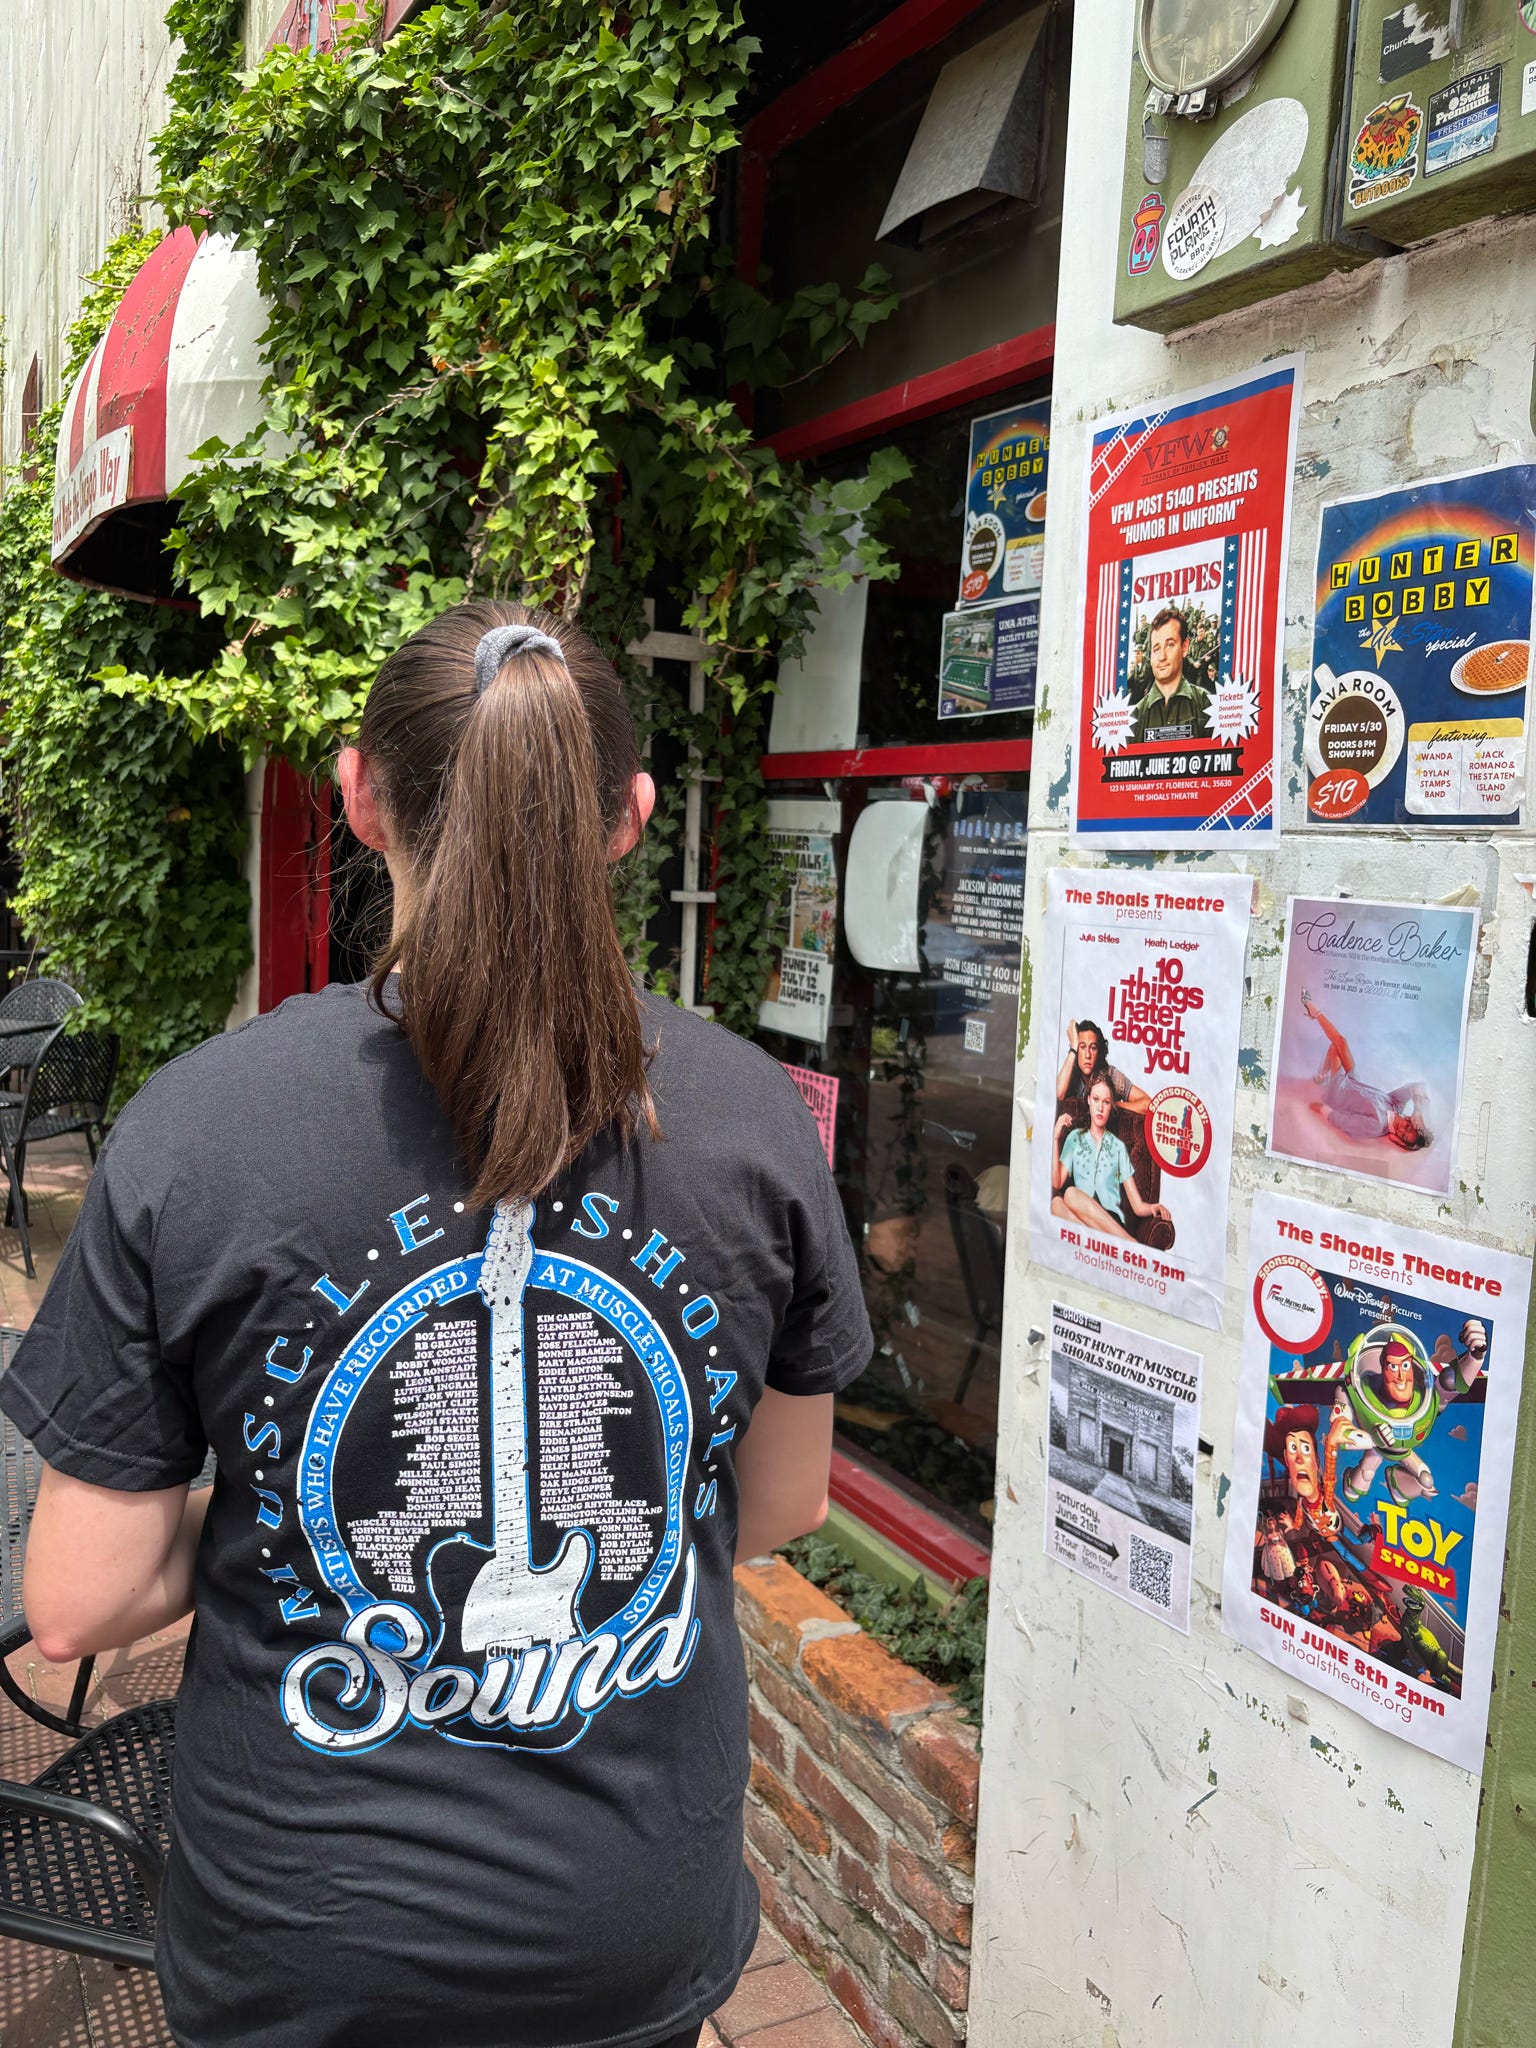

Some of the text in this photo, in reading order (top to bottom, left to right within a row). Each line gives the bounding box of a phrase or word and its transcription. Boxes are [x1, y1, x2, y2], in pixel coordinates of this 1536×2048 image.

[1384, 38, 1410, 55] Churc
[1460, 82, 1490, 107] Swift
[1438, 111, 1488, 137] FRESH PORK
[1355, 176, 1410, 206] OUTDOORS
[1167, 195, 1215, 250] FOURTH
[1170, 211, 1216, 265] PLANET
[1142, 428, 1212, 471] VFW
[100, 447, 120, 506] Way
[982, 458, 1044, 486] BOBBY
[1111, 501, 1134, 525] VFW
[1136, 491, 1164, 518] POST
[1166, 484, 1194, 511] 5140
[1197, 469, 1258, 503] PRESENTS
[1168, 514, 1180, 535] IN
[1332, 535, 1518, 588] HUNTER
[1134, 560, 1222, 604] STRIPES
[1346, 578, 1489, 621] BOBBY
[1359, 627, 1477, 658] the special
[1219, 692, 1243, 701] Tickets
[1312, 679, 1396, 721] LAVA ROOM
[1324, 721, 1381, 733] FRIDAY 5/30
[1328, 741, 1356, 749] DOORS
[1328, 750, 1355, 758] SHOW
[1481, 751, 1504, 759] JACK
[1110, 754, 1232, 778] FRIDAY, JUNE 20 @ 7 PM
[1469, 762, 1507, 770] ROMANO
[1483, 772, 1515, 780] STATEN
[1125, 783, 1154, 791] SEMINARY
[1146, 793, 1169, 801] SHOALS
[1171, 792, 1198, 800] THEATRE
[1314, 779, 1358, 809] $10
[958, 879, 1022, 897] JACKSON BROWNE
[1066, 889, 1224, 912] The Shoals Theatre
[1116, 907, 1162, 921] presents
[1098, 933, 1120, 944] Stiles
[1145, 938, 1167, 949] Heath
[1170, 940, 1199, 952] Ledger
[1296, 913, 1384, 953] Cadence
[1388, 921, 1462, 962] Baker
[783, 957, 819, 975] JUNE 14
[1156, 958, 1184, 984] 10
[781, 971, 817, 989] JULY 12
[1120, 967, 1204, 1013] things
[780, 983, 819, 1002] AUGUST
[1108, 986, 1174, 1026] I hate
[1112, 1016, 1185, 1051] about
[1144, 1048, 1190, 1074] you
[1157, 1111, 1177, 1124] The
[1156, 1123, 1193, 1139] Shoals
[1156, 1133, 1200, 1152] Theatre
[1060, 1229, 1185, 1283] FRI JUNE 6th 7pm
[1277, 1220, 1502, 1297] The Shoals Theatre
[1074, 1251, 1166, 1295] shoalstheatre.org
[1349, 1256, 1413, 1286] presents
[537, 1312, 592, 1323] KIM CARNES
[1360, 1307, 1391, 1323] presents
[1391, 1303, 1422, 1321] Pictures
[433, 1320, 477, 1331] TRAFFIC
[415, 1346, 477, 1359] JOE COCKER
[1053, 1324, 1198, 1387] GHOST HUNT AT MUSCLE
[1061, 1342, 1104, 1368] SHOALS
[1105, 1361, 1146, 1384] SOUND
[1147, 1377, 1197, 1404] STUDIO
[539, 1382, 621, 1393] LYNYRD SKYNYRD
[540, 1425, 602, 1436] SHENANDOAH
[307, 1264, 684, 1624] ARTISTS WHO HAVE RECORDED AT MUSCLE SHOALS SOUND STUDIOS
[378, 1511, 397, 1519] THE
[400, 1511, 442, 1519] ROLLING
[1055, 1505, 1098, 1534] June 21st
[620, 1539, 650, 1548] DYLAN
[1377, 1500, 1463, 1566] TOY
[357, 1543, 415, 1551] BLACKFOOT
[388, 1575, 414, 1584] CHER
[1380, 1548, 1451, 1589] STORY
[392, 1584, 416, 1593] LULU
[282, 1544, 700, 1752] Sound
[1260, 1607, 1445, 1717] SUN JUNE 8th 2pm
[1281, 1638, 1412, 1723] shoalstheatre.org
